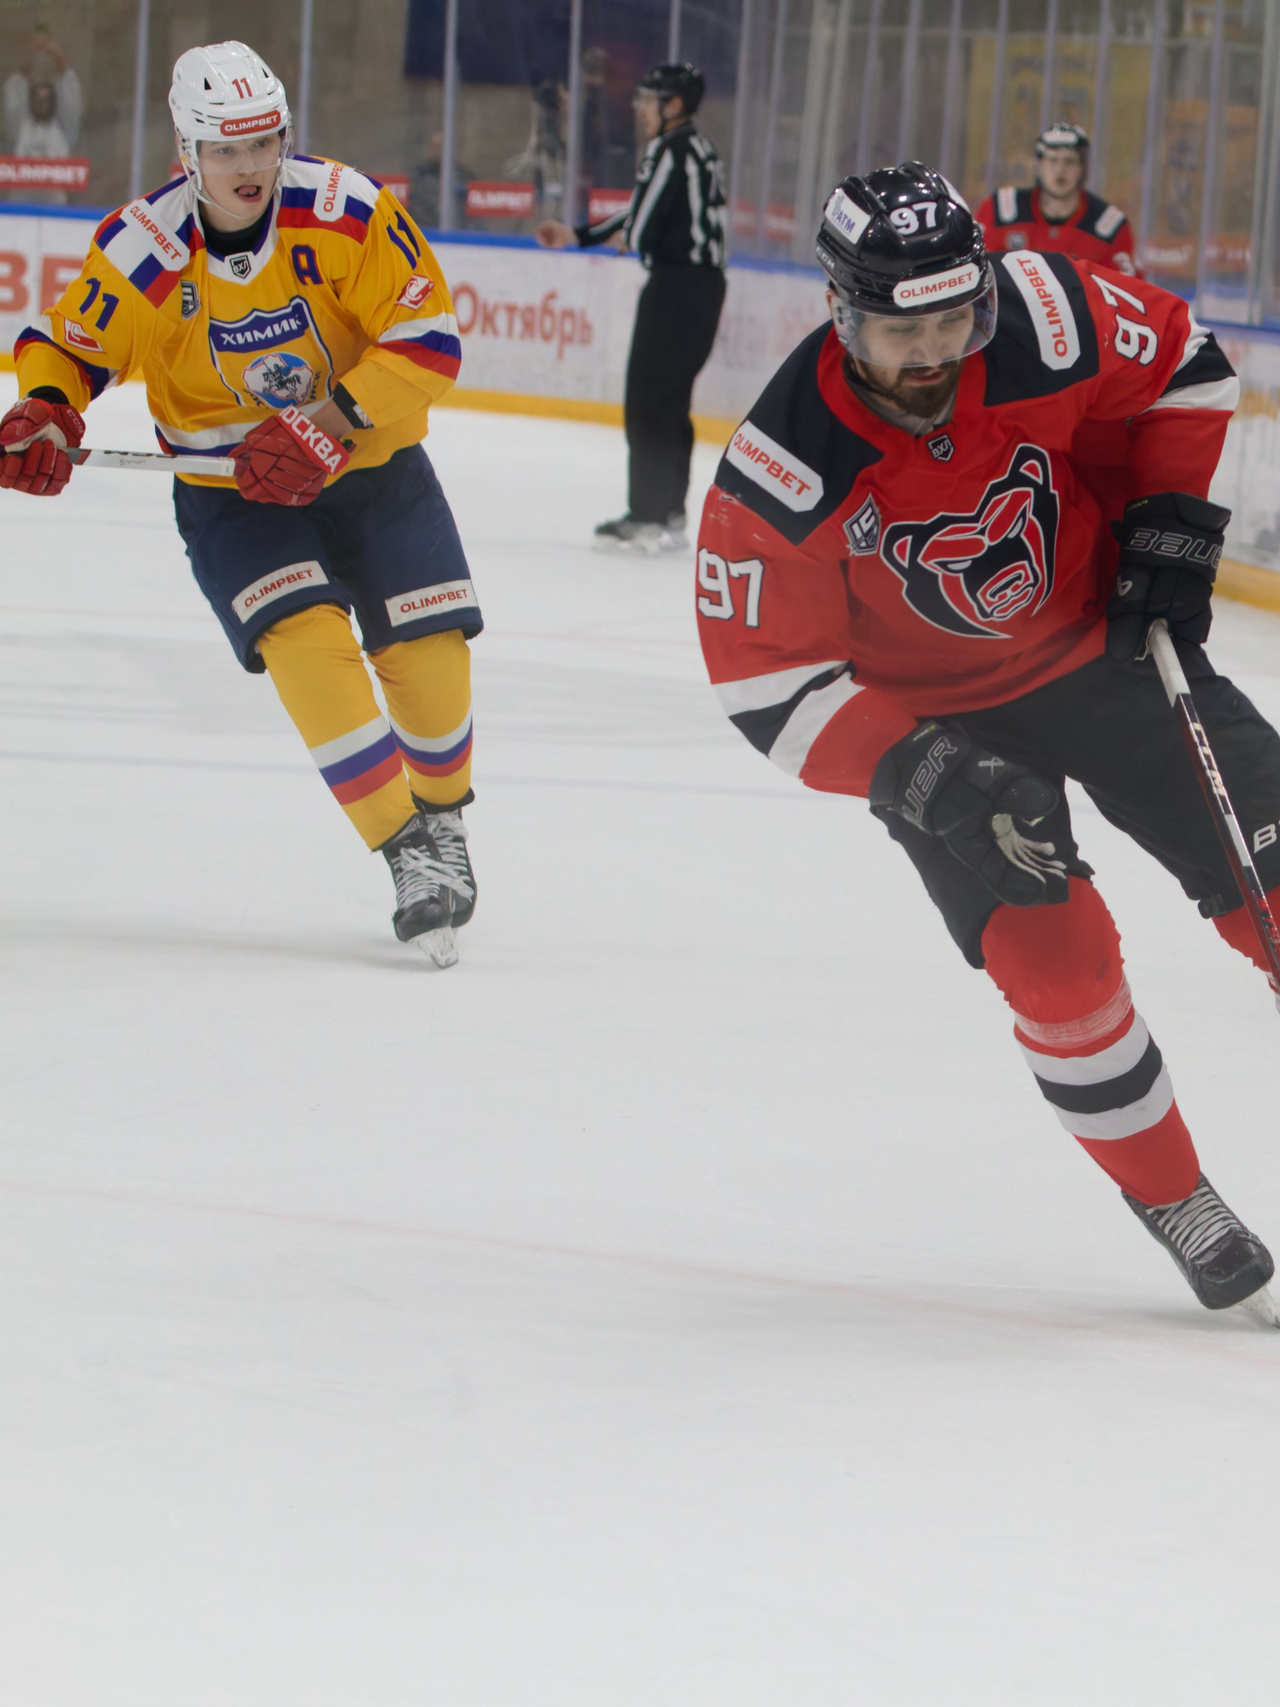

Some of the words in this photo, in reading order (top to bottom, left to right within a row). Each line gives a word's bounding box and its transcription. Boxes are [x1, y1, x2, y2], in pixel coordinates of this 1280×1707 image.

[232, 77, 253, 99] 11
[224, 114, 278, 132] OLIMPBET
[129, 205, 183, 261] OLIMPBET
[889, 201, 938, 236] 97
[291, 244, 324, 286] A
[899, 271, 974, 299] OLIMPBET
[79, 277, 120, 332] 11
[452, 281, 595, 360] Октябрь
[1016, 257, 1069, 358] OLIMPBET
[1089, 273, 1158, 366] 97
[220, 314, 302, 345] ХИМИК
[279, 404, 342, 474] ОСКВА
[733, 433, 812, 496] OLIMPBET
[244, 569, 313, 609] OLIMPBET
[400, 588, 468, 614] OLIMPBET
[698, 547, 765, 628] 97
